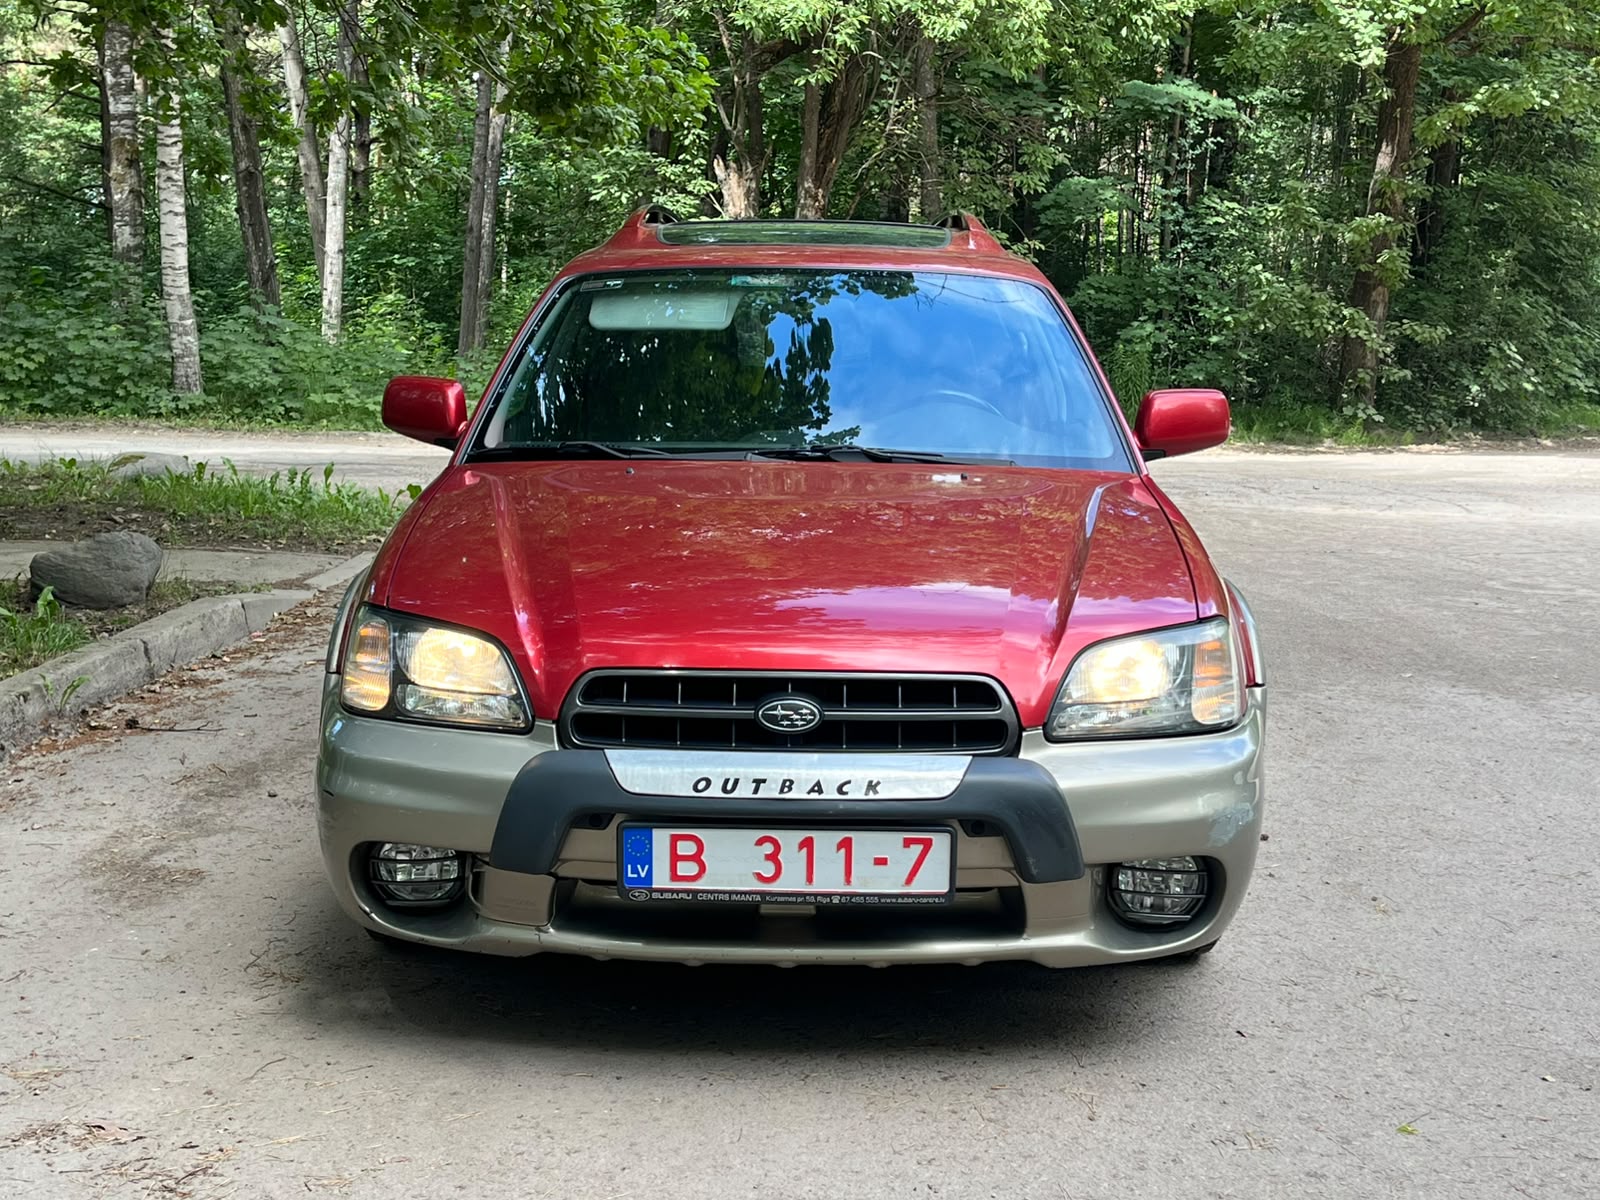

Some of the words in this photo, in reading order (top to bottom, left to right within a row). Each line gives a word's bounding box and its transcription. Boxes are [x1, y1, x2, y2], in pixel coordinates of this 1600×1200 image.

[691, 776, 882, 797] OUTBACK
[669, 833, 707, 883] B
[752, 835, 934, 886] 311-7
[627, 864, 649, 878] LV
[652, 892, 692, 900] SUBARU
[697, 893, 730, 901] CENTRS
[731, 893, 762, 901] IMANTA
